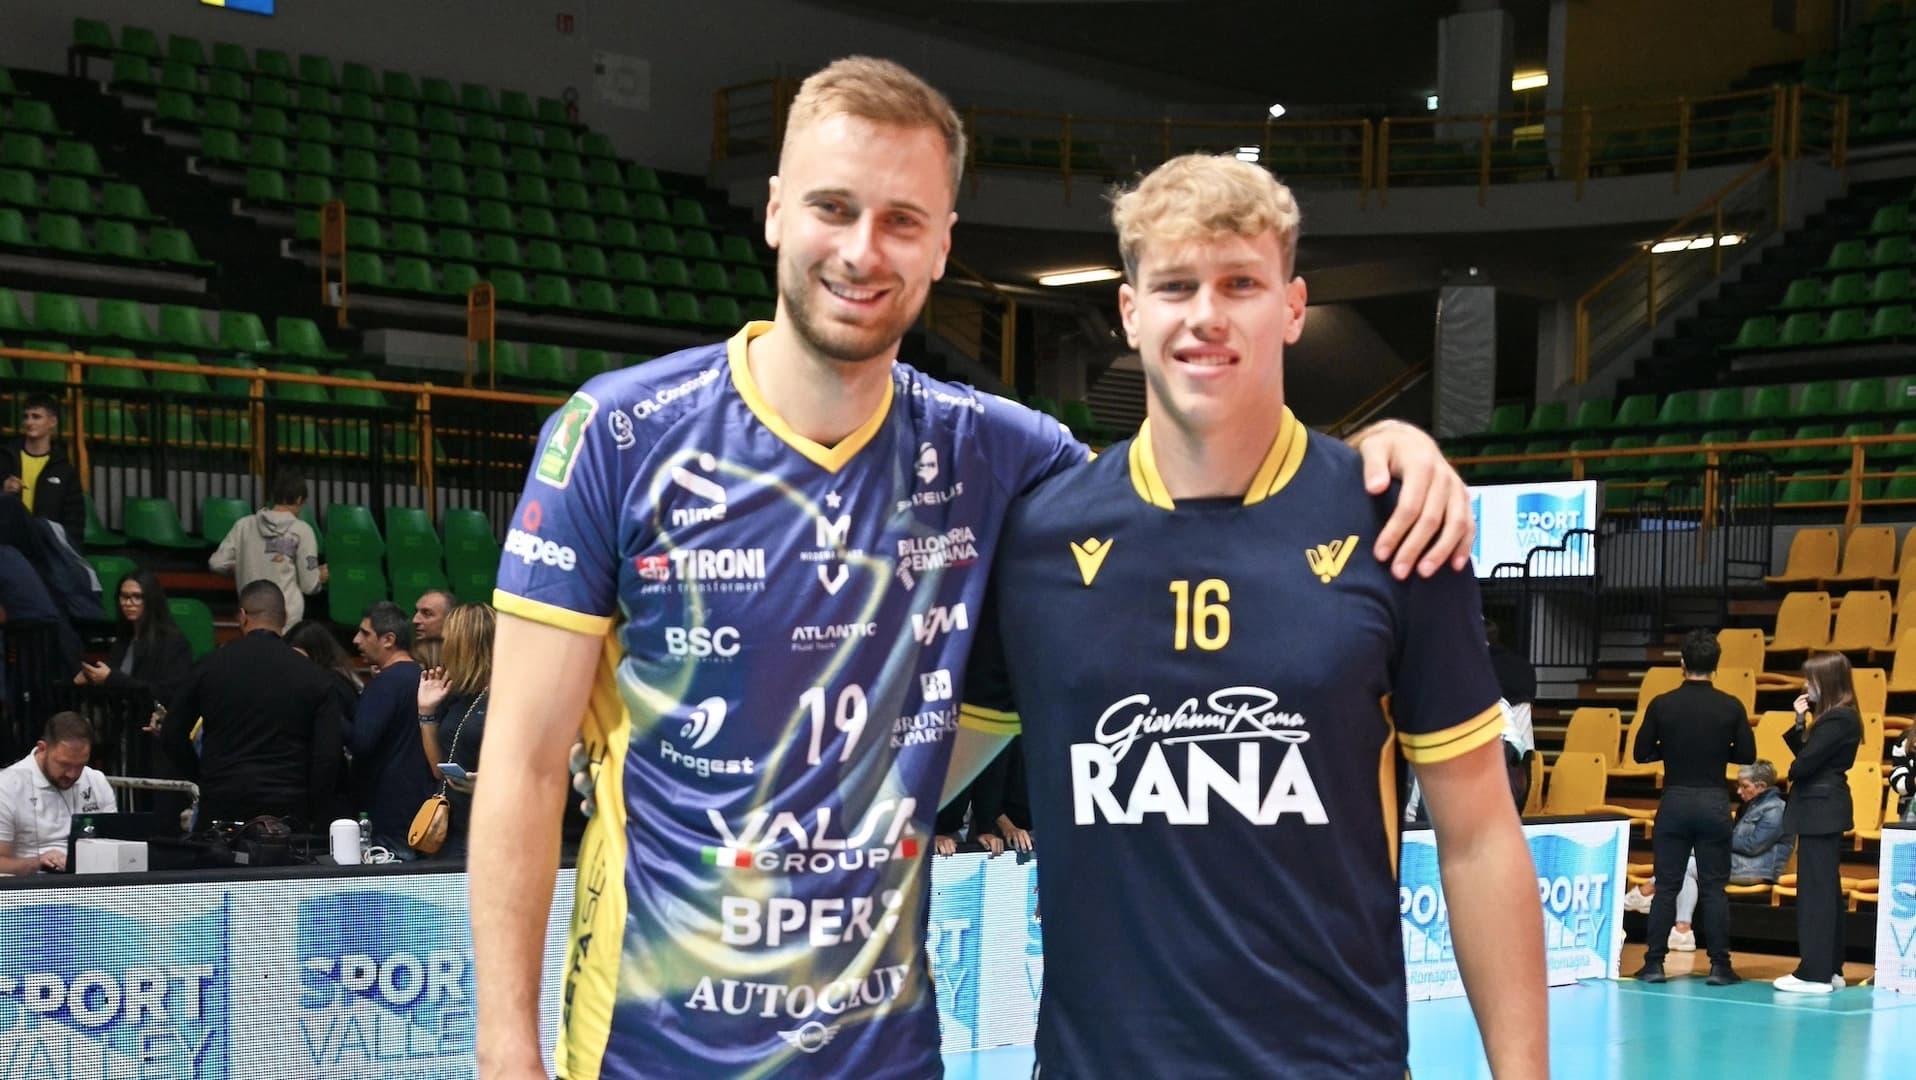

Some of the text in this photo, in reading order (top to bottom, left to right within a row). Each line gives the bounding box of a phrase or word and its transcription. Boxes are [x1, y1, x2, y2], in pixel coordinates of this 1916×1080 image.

[672, 503, 727, 527] nine
[1517, 510, 1581, 531] SPORT
[669, 548, 766, 580] TIRONI
[792, 622, 878, 641] ATLANTIC
[1169, 578, 1231, 651] 16
[665, 626, 741, 657] BSC
[799, 684, 868, 766] 19
[903, 726, 945, 748] PART
[1095, 686, 1311, 764] Giovanni Rana
[660, 739, 755, 778] Progest
[1070, 742, 1330, 825] RANA
[754, 848, 890, 873] GROUP
[1539, 873, 1609, 914] PORT
[301, 948, 472, 1010] SPOR
[1410, 967, 1457, 986] Romagna
[300, 1009, 472, 1065] VALLE
